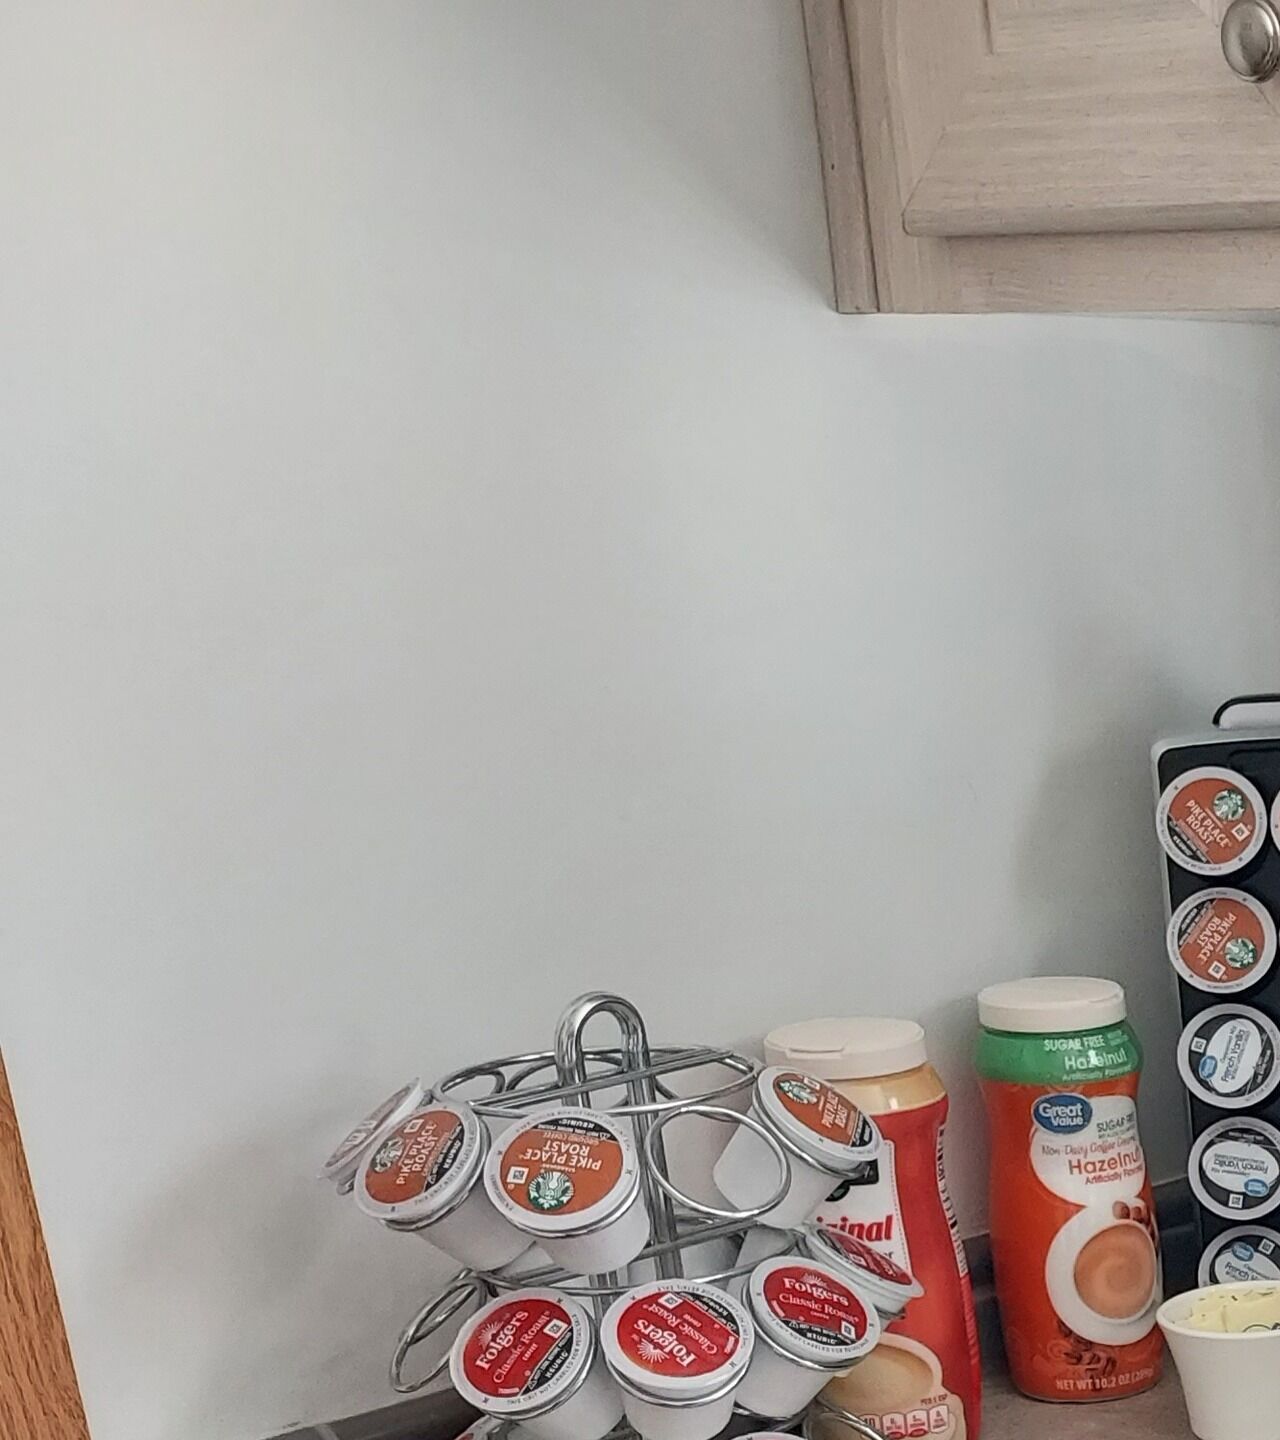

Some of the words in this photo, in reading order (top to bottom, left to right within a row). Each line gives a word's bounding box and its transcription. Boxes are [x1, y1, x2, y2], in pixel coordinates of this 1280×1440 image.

[1184, 813, 1214, 845] ROAST
[1185, 799, 1206, 822] PIKE
[1202, 818, 1229, 848] PLACE
[1195, 915, 1221, 947] ROAST
[1215, 912, 1236, 935] PIKE
[1196, 933, 1220, 962] PLACE
[1044, 1038, 1082, 1051] SUGAR
[1084, 1035, 1106, 1048] FREE
[1065, 1048, 1128, 1071] Hazelnut
[1038, 1103, 1083, 1117] Great
[1051, 1114, 1084, 1126] Value
[394, 1156, 418, 1187] PIKE
[408, 1120, 437, 1158] PLACE
[411, 1132, 439, 1174] ROAST
[524, 1148, 567, 1165] PLACE
[543, 1139, 591, 1156] ROAST
[568, 1154, 603, 1171] PIKE
[777, 1291, 823, 1312] Classic
[780, 1275, 849, 1308] Folgers
[648, 1302, 680, 1328] Roast
[474, 1308, 531, 1372] Folgers
[489, 1342, 525, 1385] Classic
[519, 1312, 549, 1345] Roast
[631, 1318, 697, 1366] Folgers
[675, 1321, 719, 1355] Classic
[1056, 1379, 1075, 1391] NET
[1077, 1379, 1093, 1391] WT
